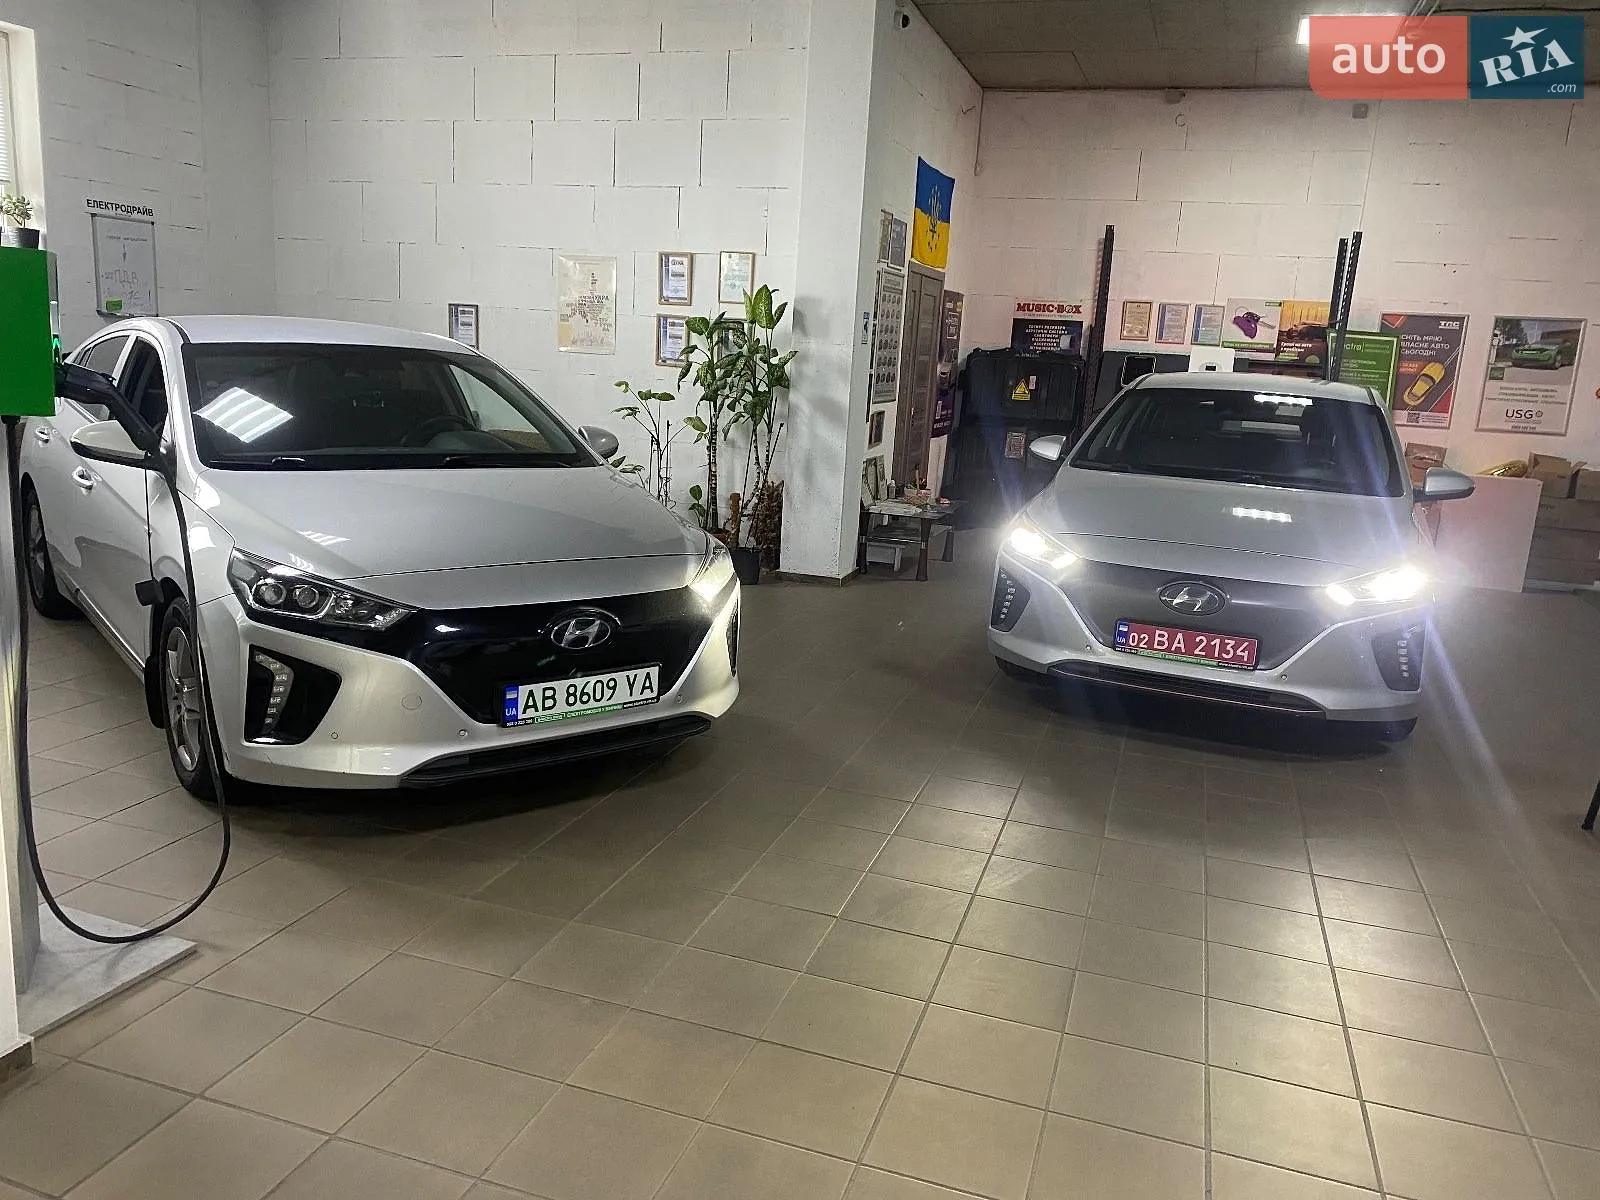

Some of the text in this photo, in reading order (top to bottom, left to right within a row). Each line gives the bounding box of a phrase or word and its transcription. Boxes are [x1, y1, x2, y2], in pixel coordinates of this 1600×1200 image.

[86, 199, 154, 216] ЕЛЕКТРОДРАЙВ
[1401, 348, 1436, 356] СЬОГОДНІ
[1505, 408, 1534, 419] USG
[1117, 636, 1126, 644] UA
[1129, 629, 1249, 661] 02 BA 2134
[521, 671, 654, 715] AB 8609 YA
[505, 708, 517, 716] UA
